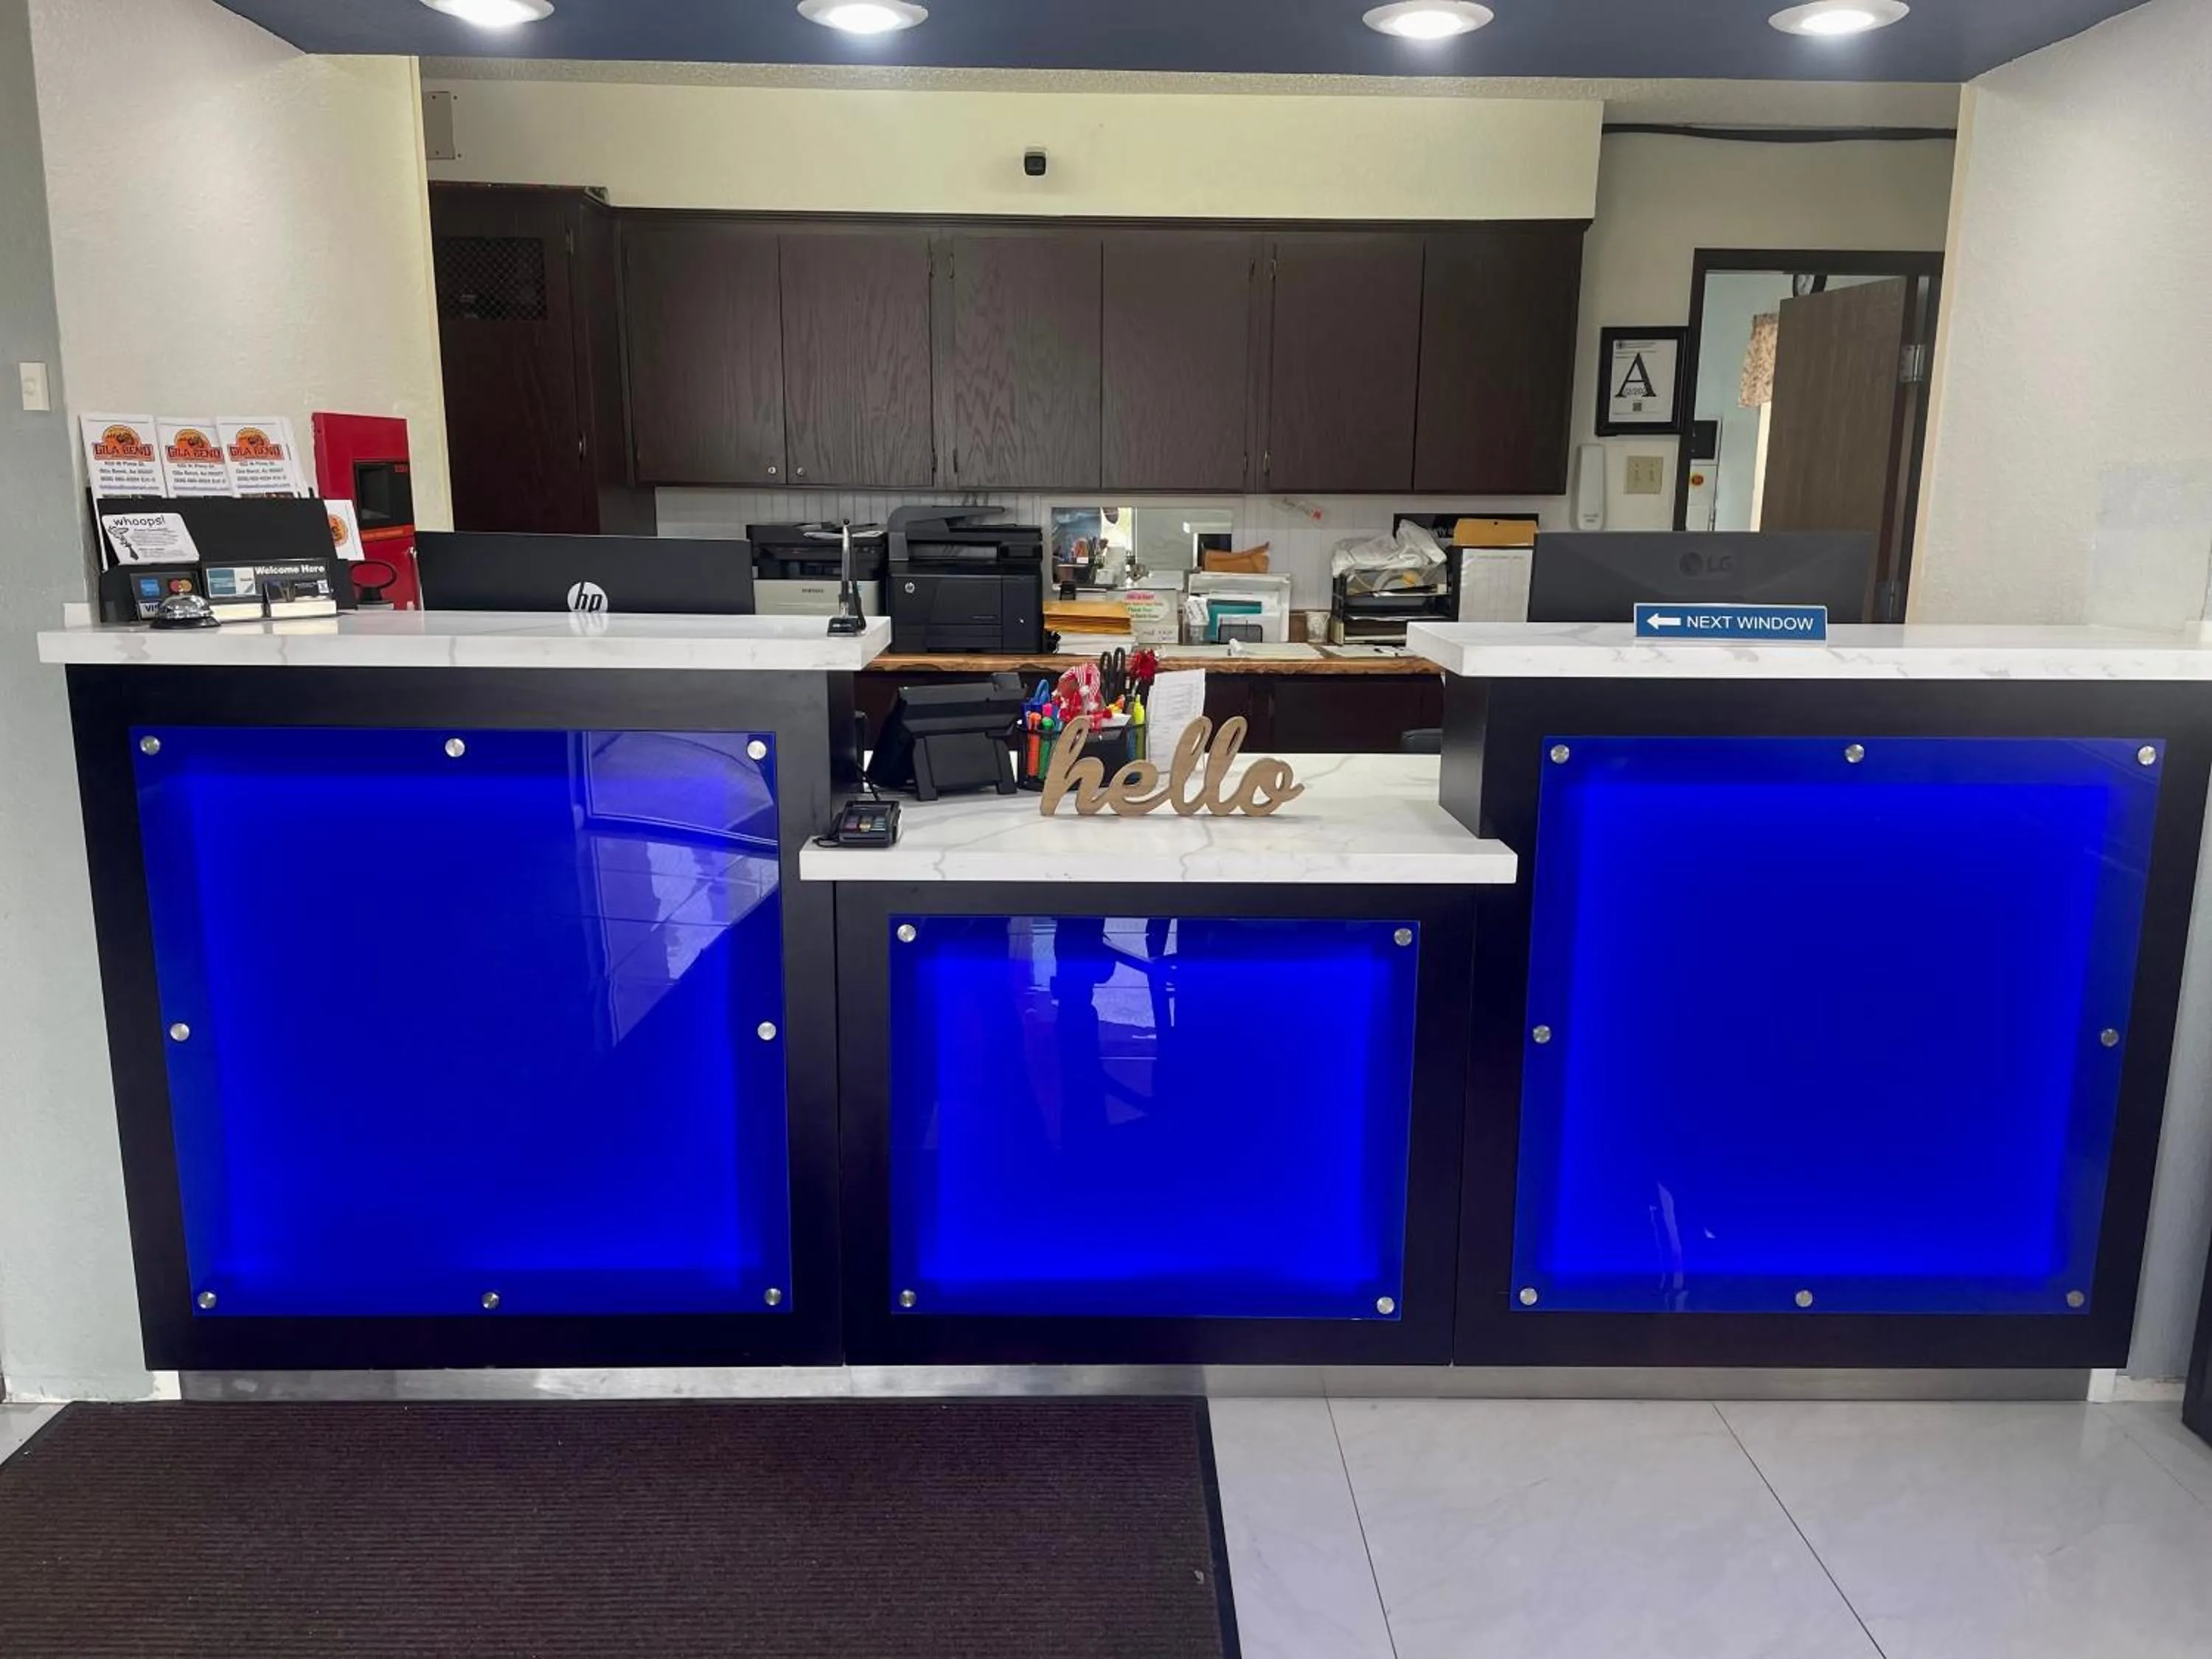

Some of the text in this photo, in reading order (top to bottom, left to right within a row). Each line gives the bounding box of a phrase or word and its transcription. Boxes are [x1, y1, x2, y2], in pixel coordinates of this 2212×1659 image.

[1614, 352, 1657, 398] A
[113, 514, 166, 527] whoops!
[254, 564, 325, 575] Welcome Here
[1706, 554, 1733, 574] LG
[573, 581, 604, 613] hp
[1686, 615, 1815, 631] NEXT WINDOW
[1040, 715, 1305, 816] hello
